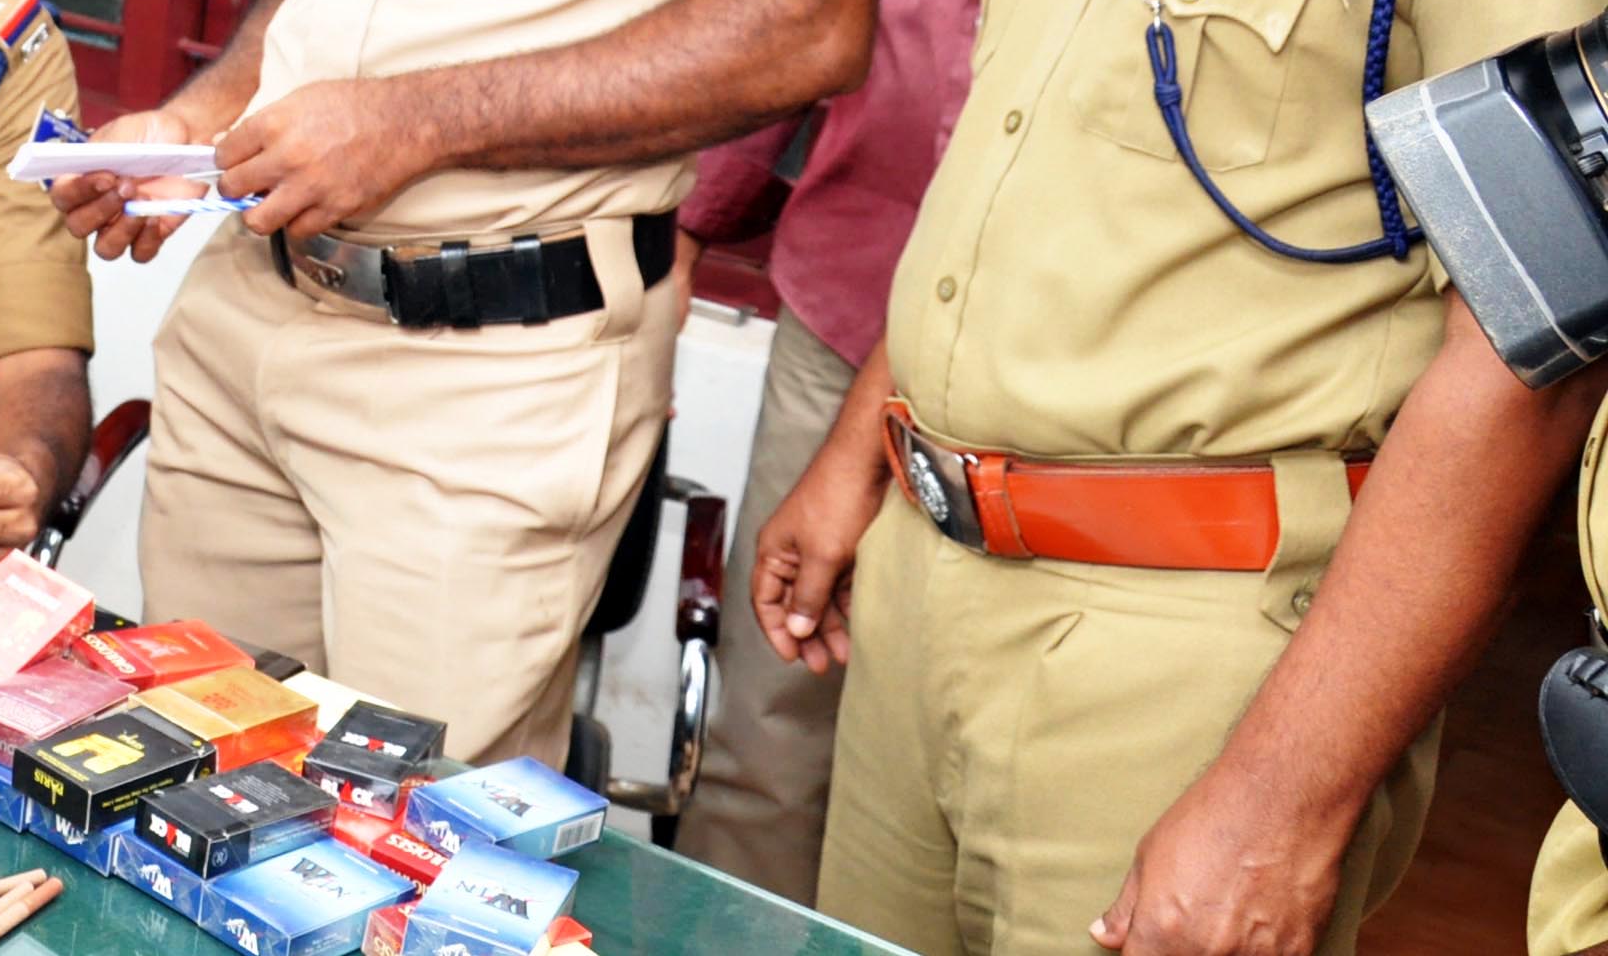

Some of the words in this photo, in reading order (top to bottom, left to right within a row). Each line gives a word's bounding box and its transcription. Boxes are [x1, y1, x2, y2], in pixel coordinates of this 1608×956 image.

[34, 768, 64, 806] PARIS
[320, 777, 375, 807] BLACK
[149, 813, 192, 854] BLACK
